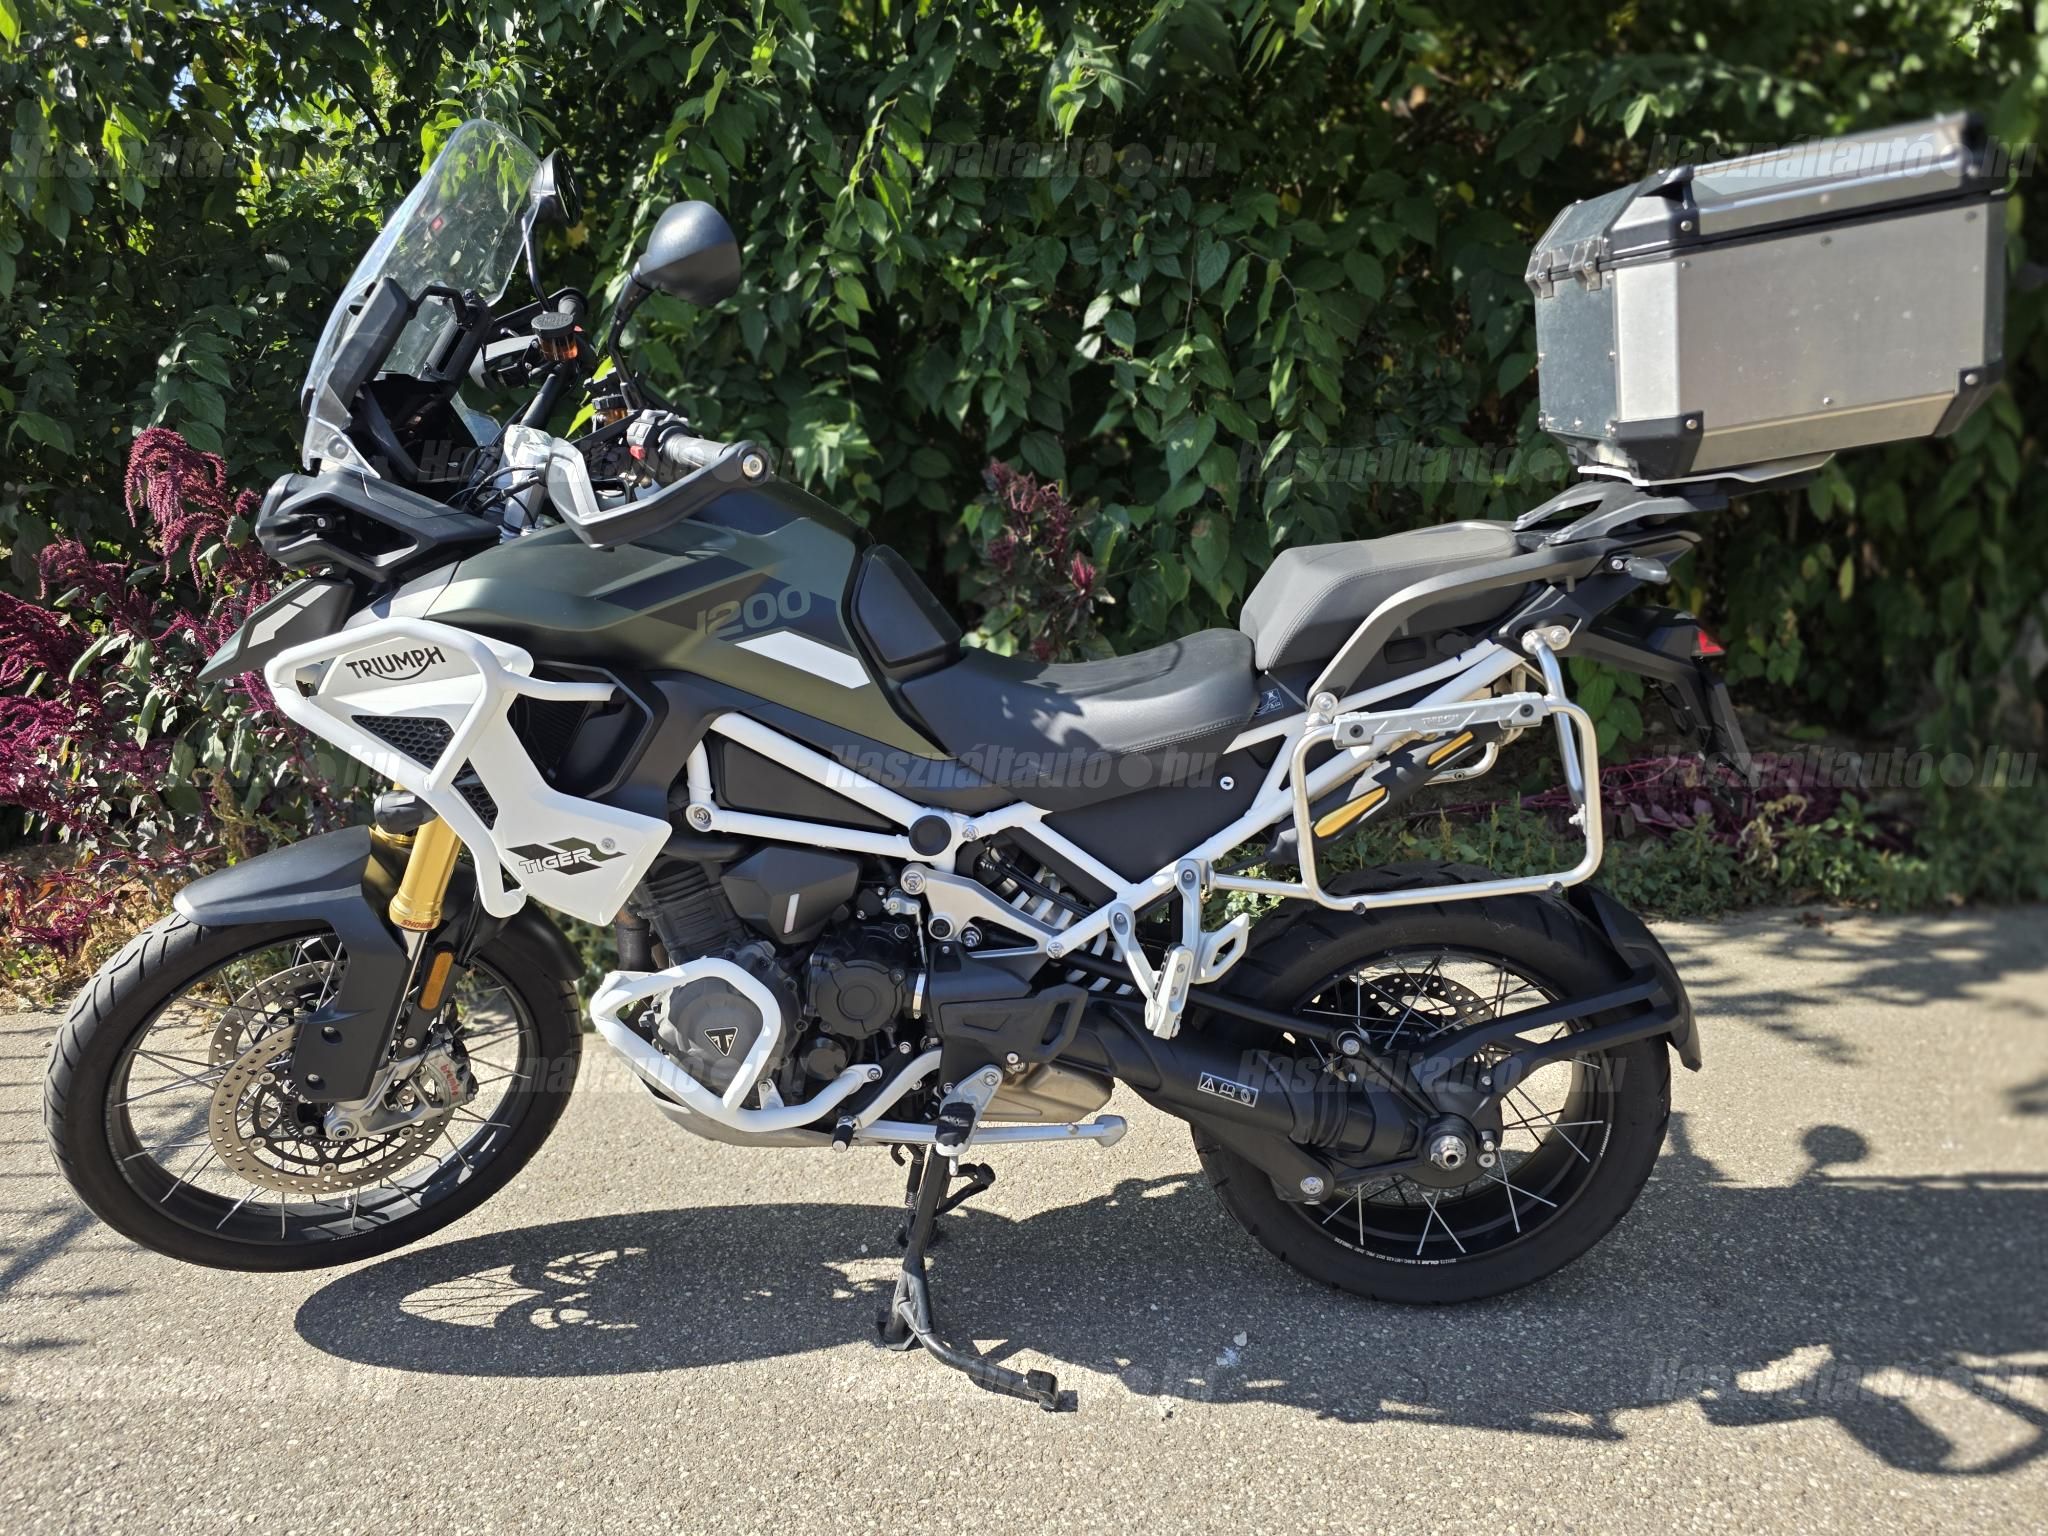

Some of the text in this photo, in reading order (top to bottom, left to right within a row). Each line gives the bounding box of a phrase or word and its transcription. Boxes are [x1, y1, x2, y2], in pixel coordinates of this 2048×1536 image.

[697, 585, 812, 639] 1200
[345, 646, 446, 680] TRIUMPH
[519, 847, 593, 874] TIGER
